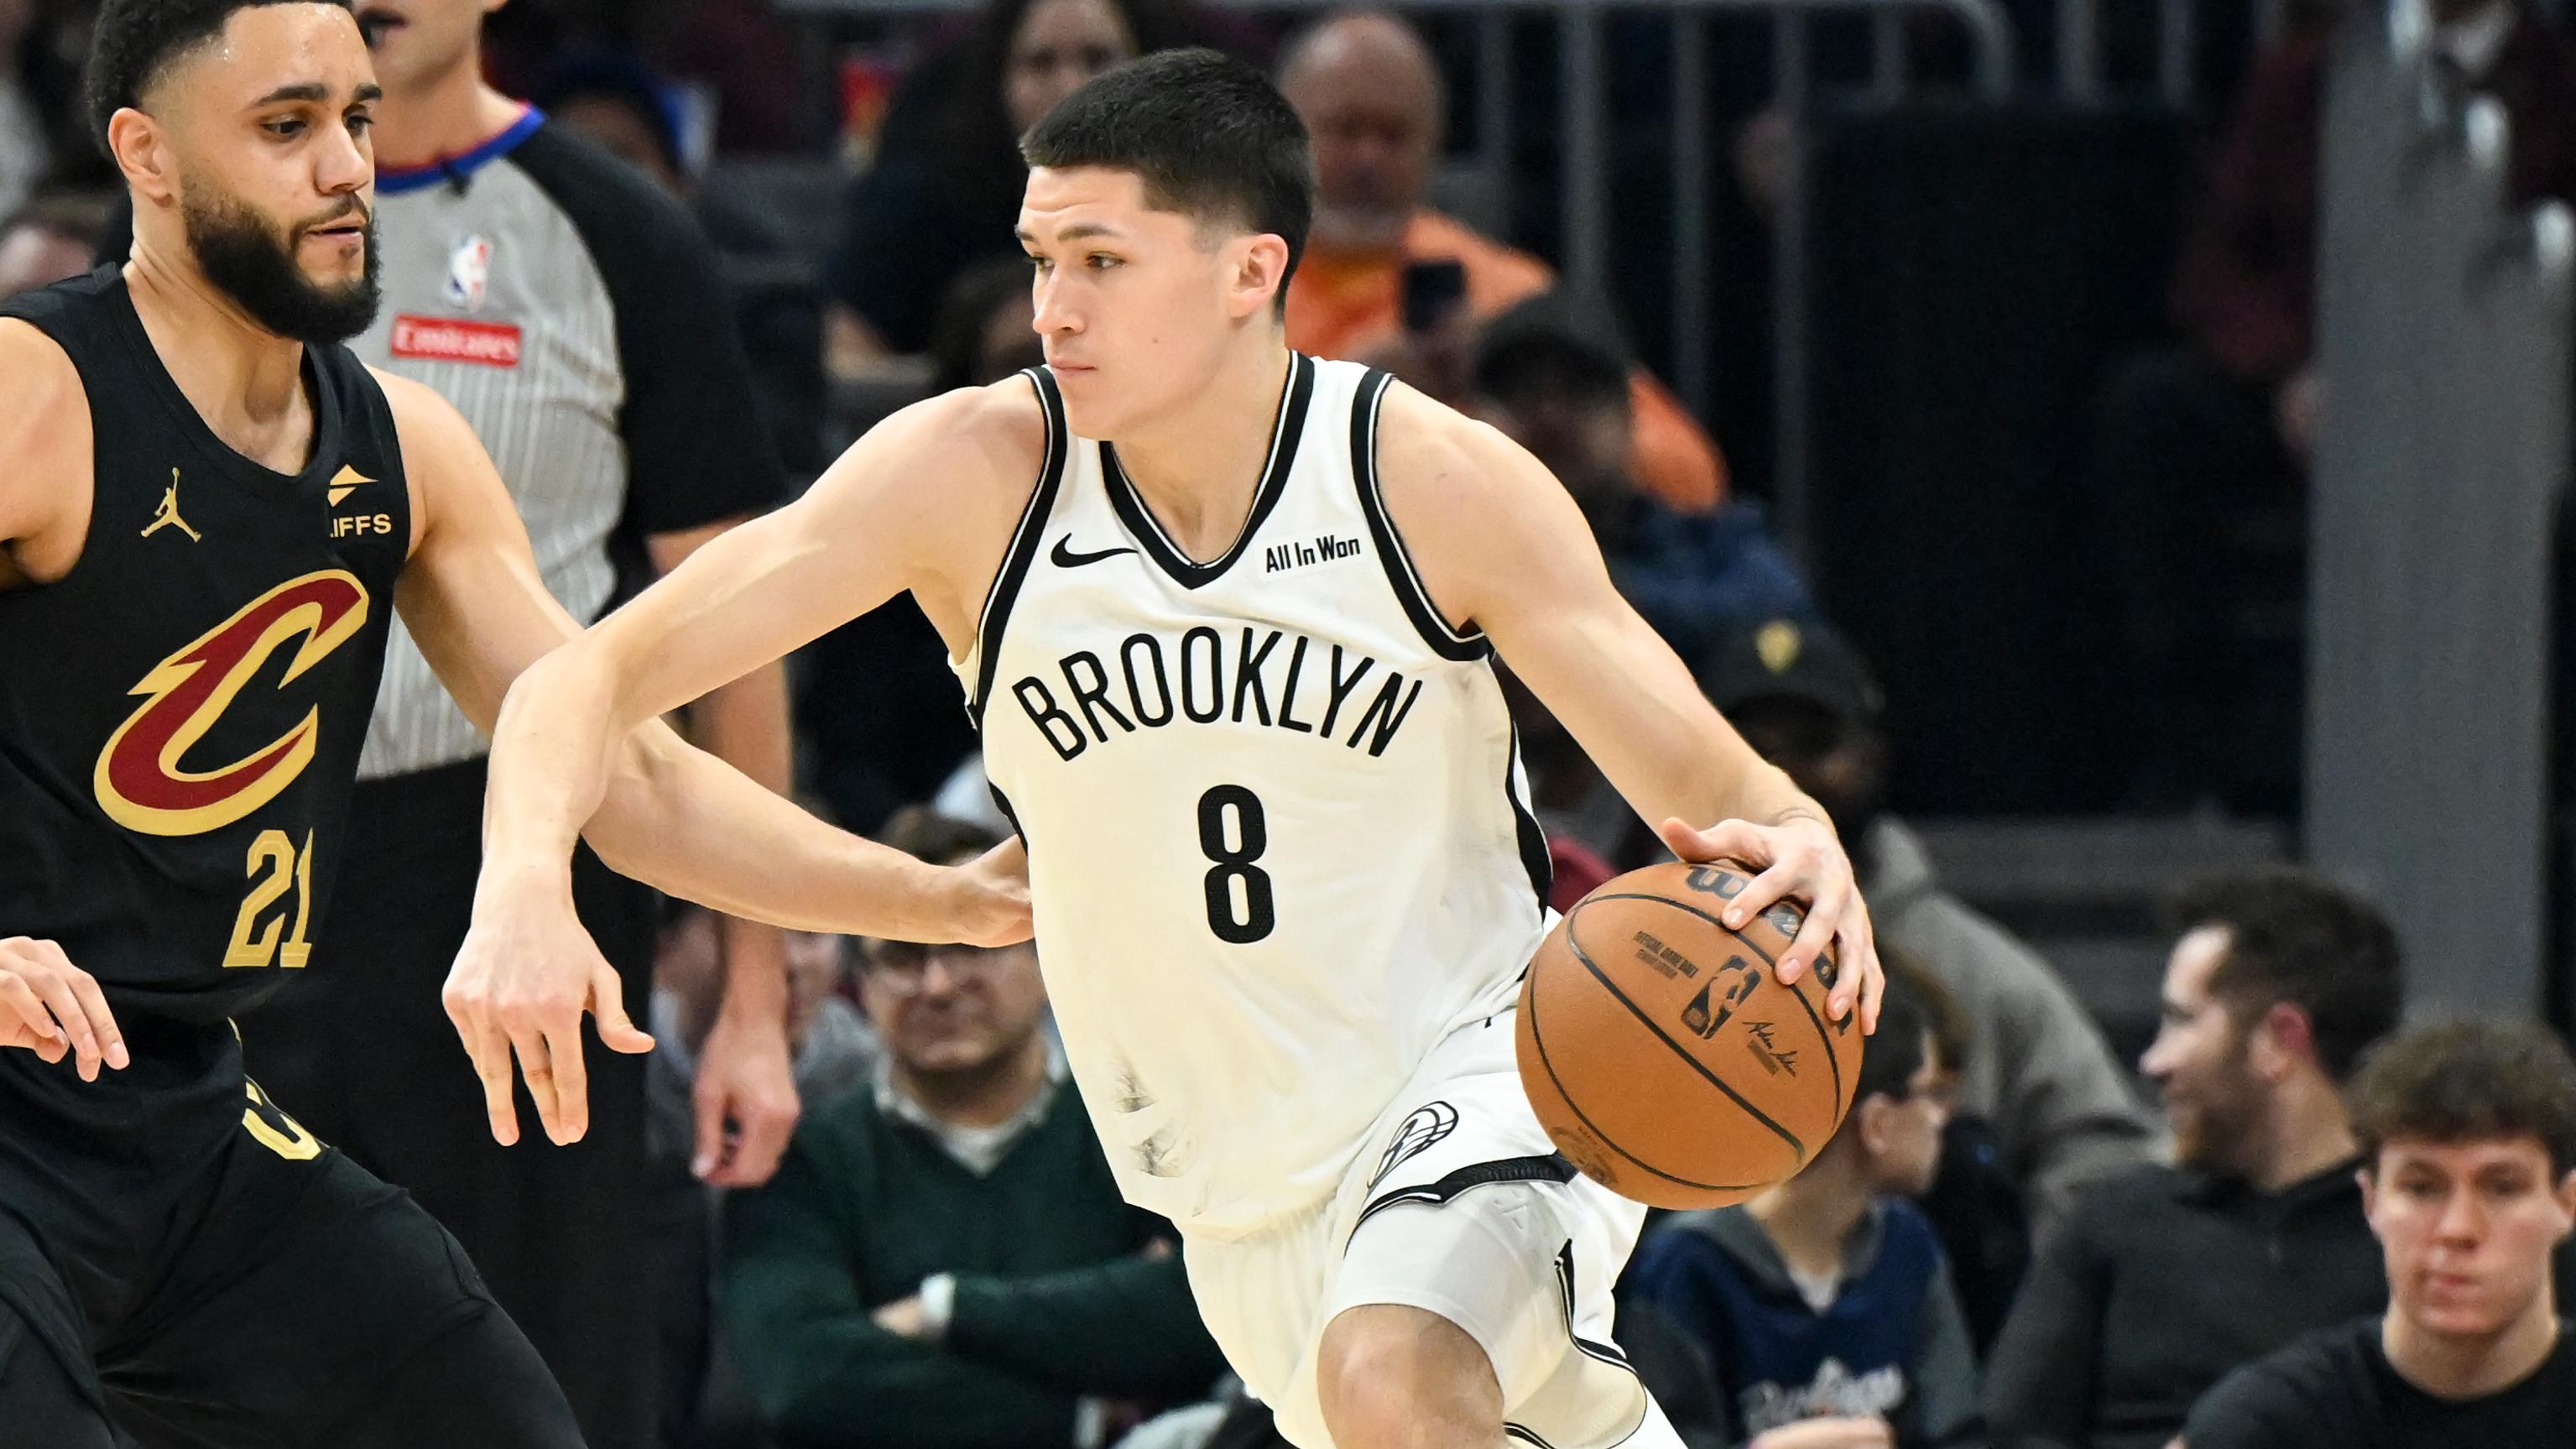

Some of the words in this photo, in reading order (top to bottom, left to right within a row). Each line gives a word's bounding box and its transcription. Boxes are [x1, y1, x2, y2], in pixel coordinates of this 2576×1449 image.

[330, 513, 392, 538] IFFS
[1265, 547, 1291, 573] All
[1294, 541, 1316, 566] In
[1316, 534, 1360, 562] Won
[1012, 626, 1423, 762] BROOKLYN
[222, 828, 314, 967] 21
[1197, 784, 1275, 944] 8
